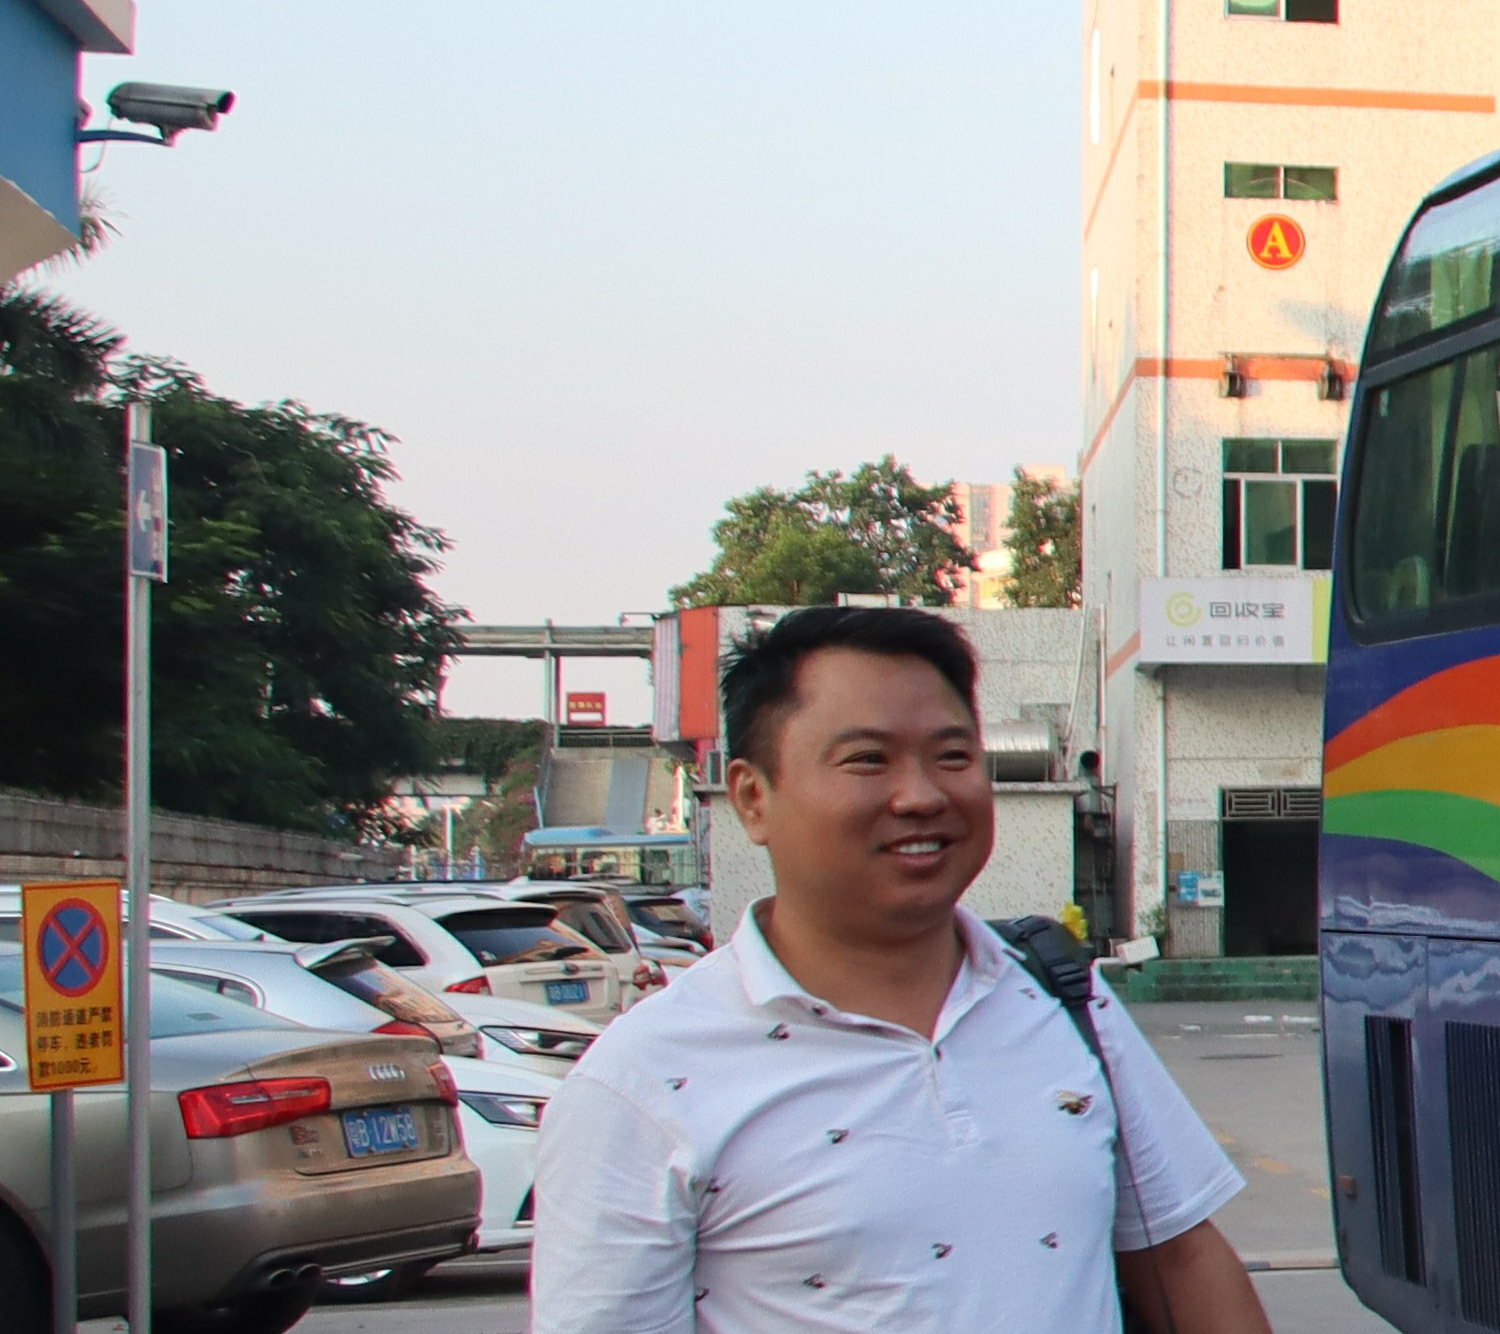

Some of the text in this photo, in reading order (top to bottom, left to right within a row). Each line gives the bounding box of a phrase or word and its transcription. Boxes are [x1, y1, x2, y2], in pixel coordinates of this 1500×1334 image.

[1259, 220, 1293, 258] A
[1209, 601, 1285, 619] 回收宝
